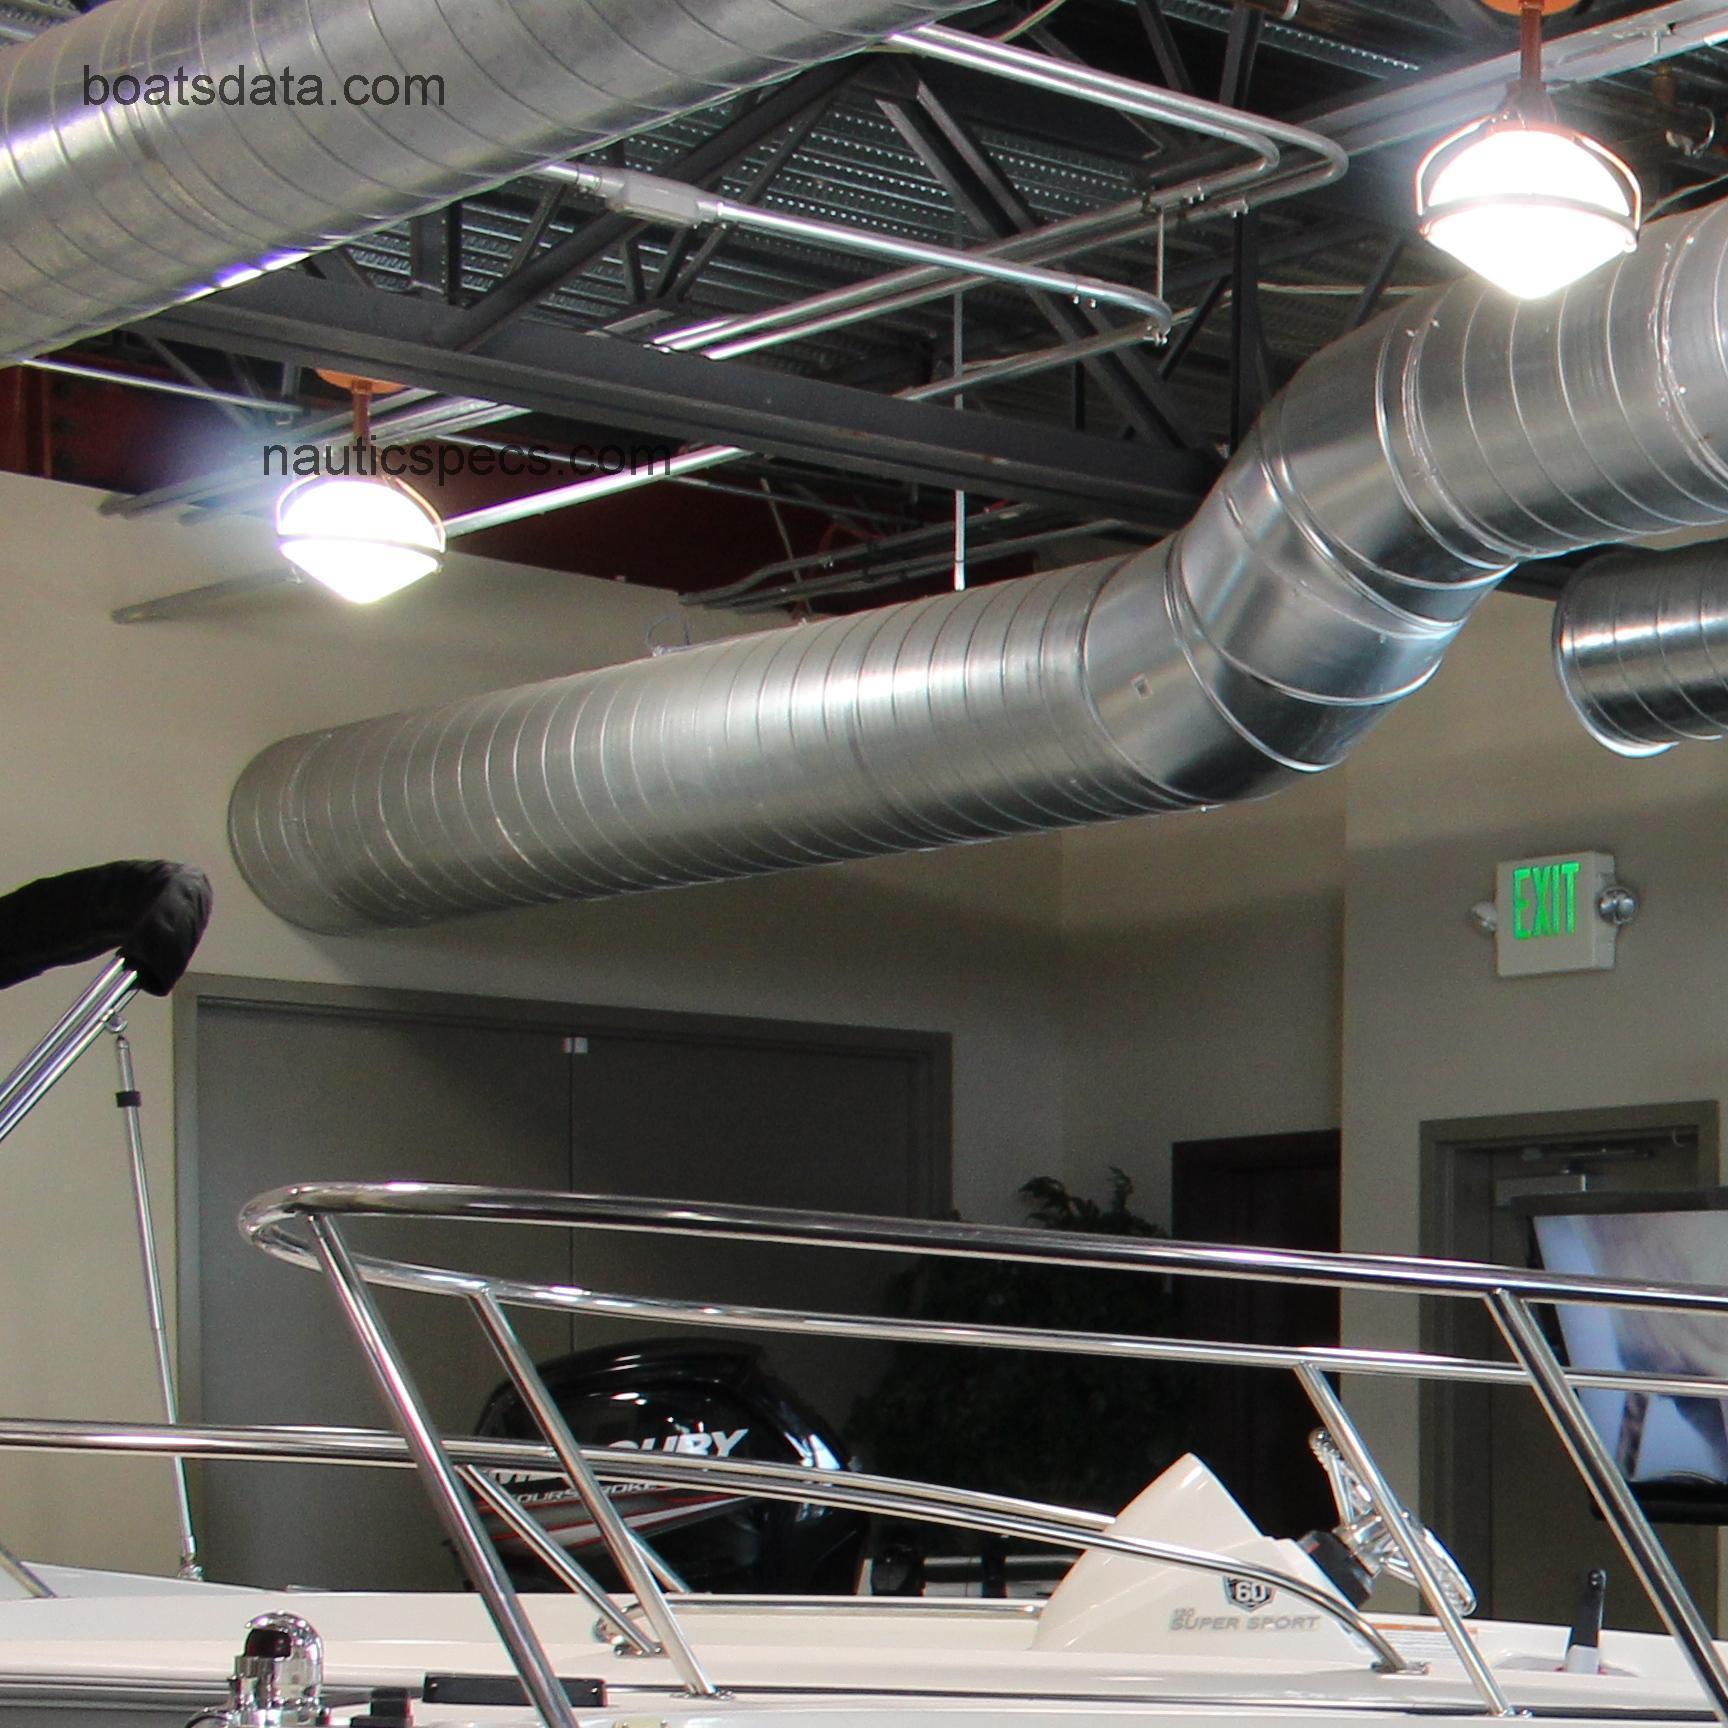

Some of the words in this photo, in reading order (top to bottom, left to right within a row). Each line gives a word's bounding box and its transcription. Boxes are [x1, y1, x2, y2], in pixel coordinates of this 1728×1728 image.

[1513, 862, 1580, 940] EXIT
[1235, 1581, 1267, 1602] 60
[1170, 1616, 1240, 1631] SUPER
[1246, 1615, 1321, 1631] SPORT
